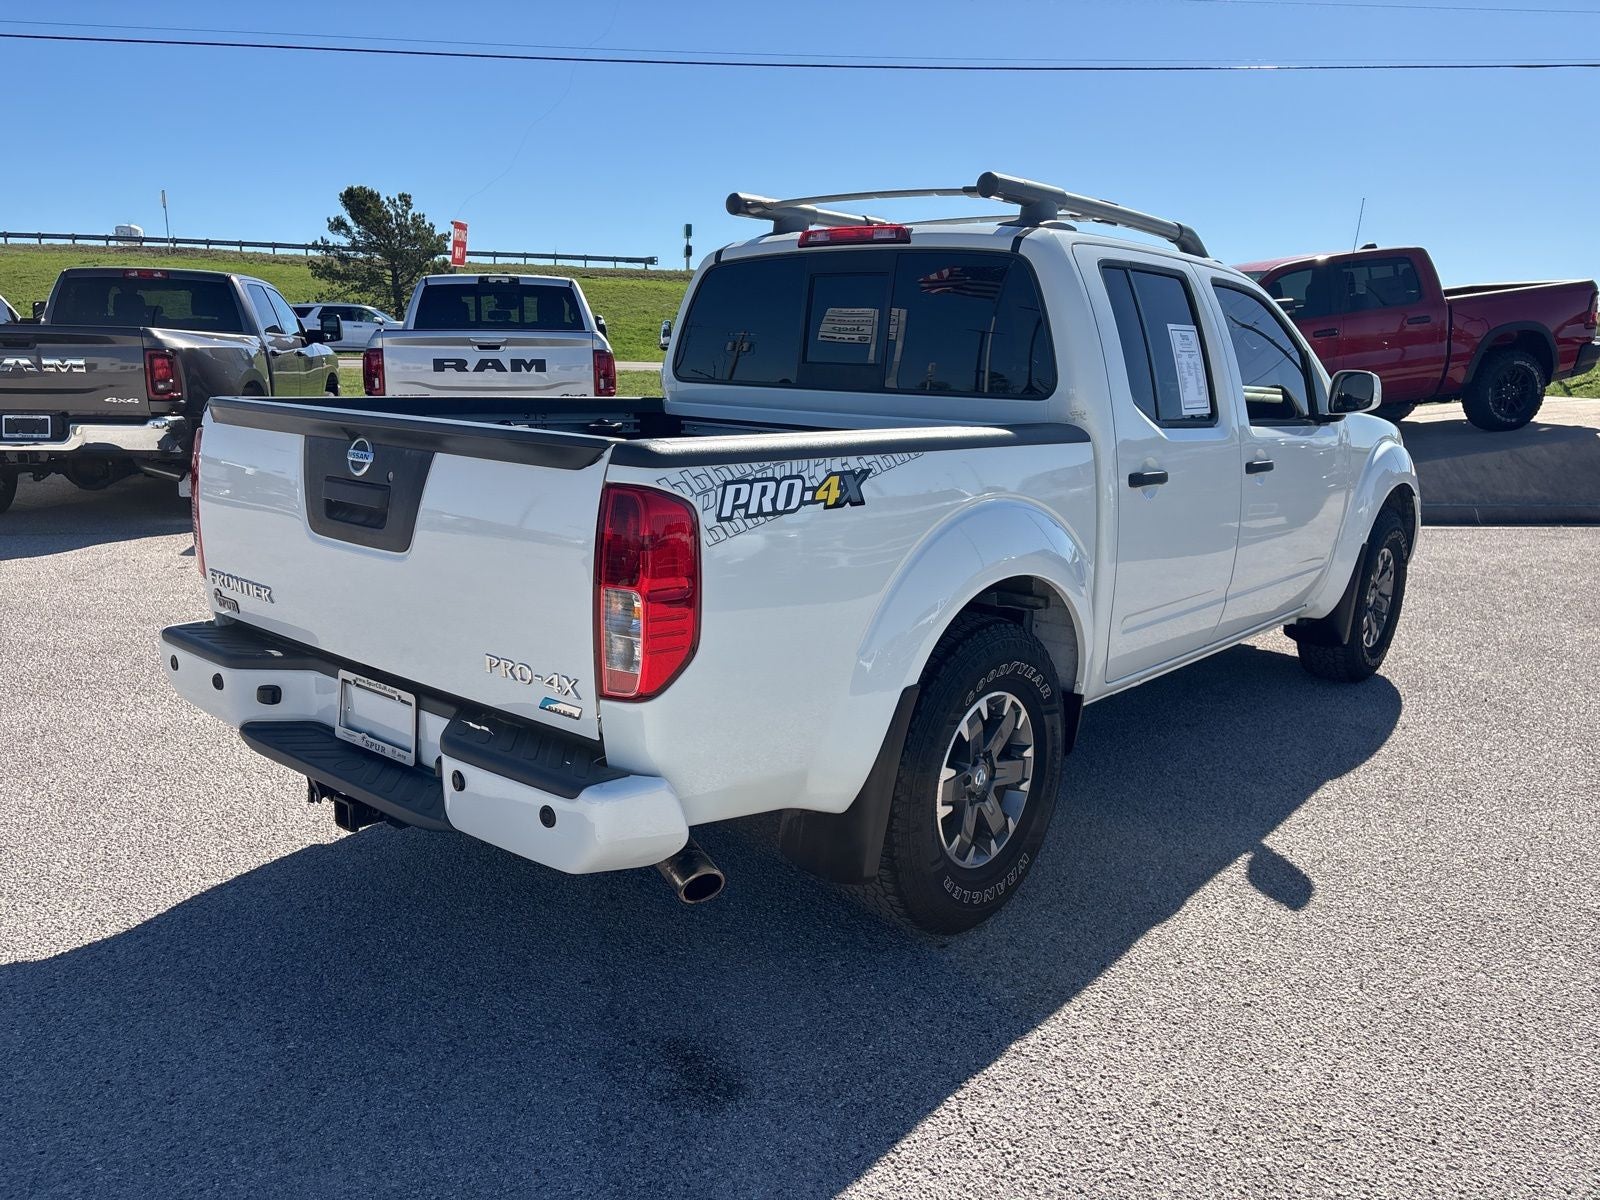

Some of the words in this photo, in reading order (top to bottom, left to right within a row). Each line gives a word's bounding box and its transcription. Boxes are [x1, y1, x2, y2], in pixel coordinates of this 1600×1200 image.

[455, 246, 463, 259] WAY
[0, 357, 87, 373] AM
[432, 358, 547, 373] RAM
[348, 451, 370, 461] NISSAN
[716, 469, 872, 522] PRO-4X
[209, 568, 275, 604] FRONTIER
[218, 597, 239, 613] SPUR
[484, 653, 582, 700] PRO-4X
[965, 660, 1052, 706] GOODYEAR
[365, 740, 386, 754] SPUR
[943, 853, 1030, 904] WRANGLER
